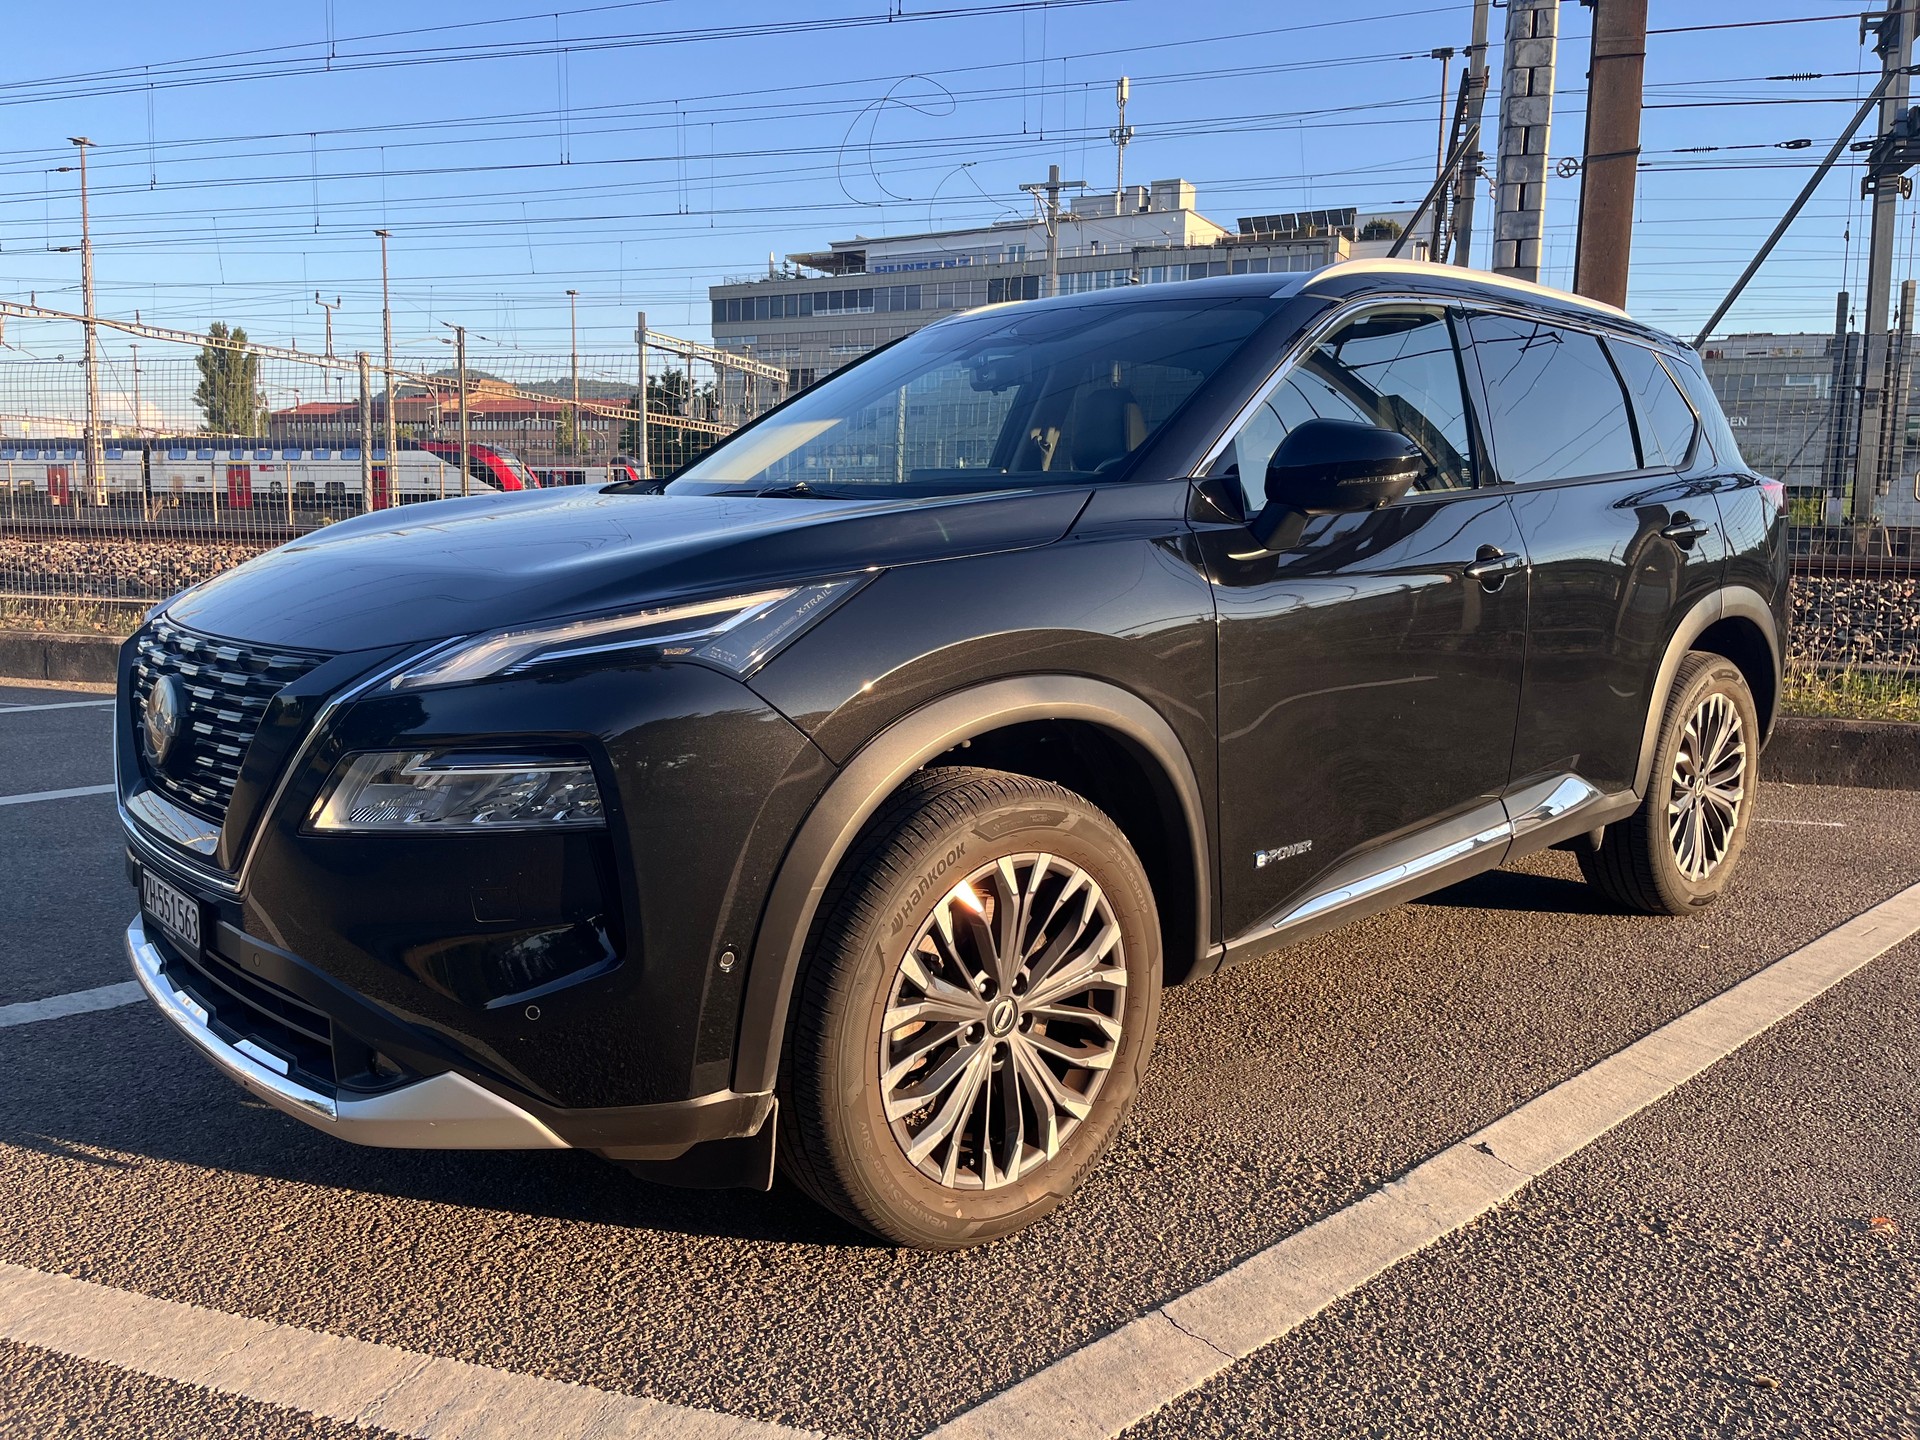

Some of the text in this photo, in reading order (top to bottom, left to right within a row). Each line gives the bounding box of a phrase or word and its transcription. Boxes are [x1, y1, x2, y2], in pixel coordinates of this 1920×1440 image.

[796, 590, 832, 615] X-TRAIL
[1107, 847, 1149, 914] 235/55R19
[858, 1121, 873, 1150] SUV
